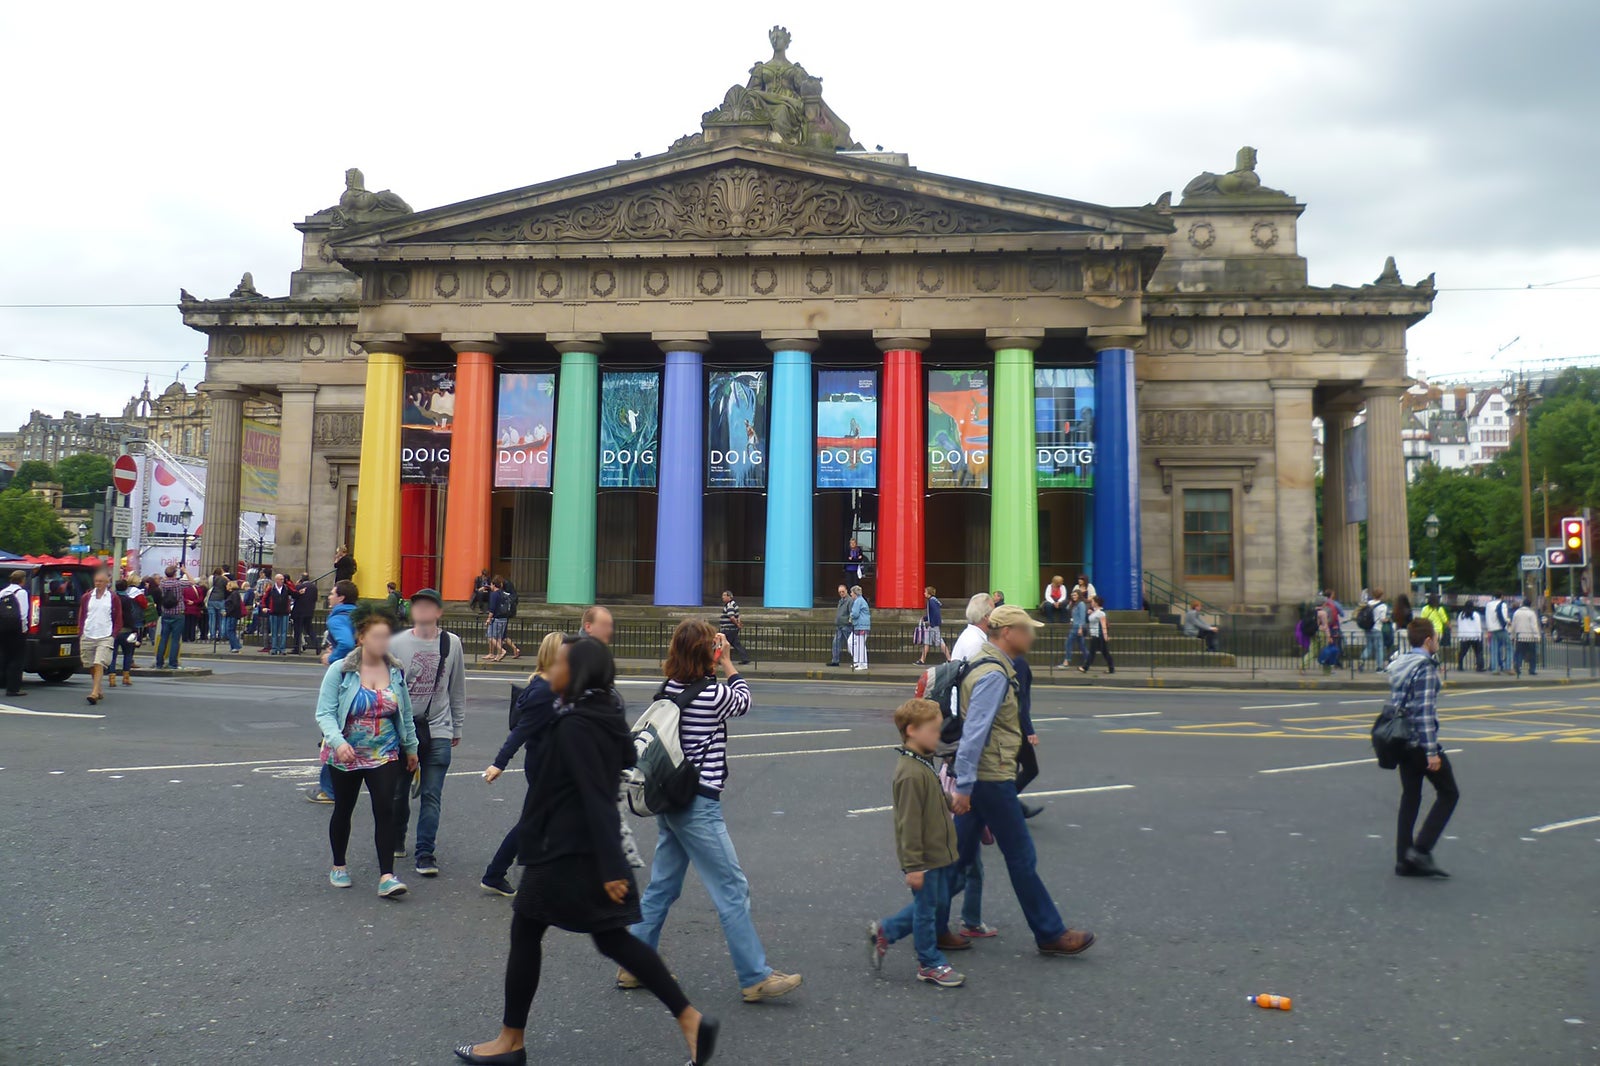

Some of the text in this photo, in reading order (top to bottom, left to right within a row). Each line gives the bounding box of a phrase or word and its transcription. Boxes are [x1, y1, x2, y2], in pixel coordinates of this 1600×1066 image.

[402, 448, 450, 463] DOIG
[499, 450, 549, 465] DOIG
[603, 450, 654, 464] DOIG
[710, 450, 762, 465] DOIG
[820, 449, 873, 464] DOIG
[931, 449, 985, 465] DOIG
[1038, 449, 1092, 464] DOIG
